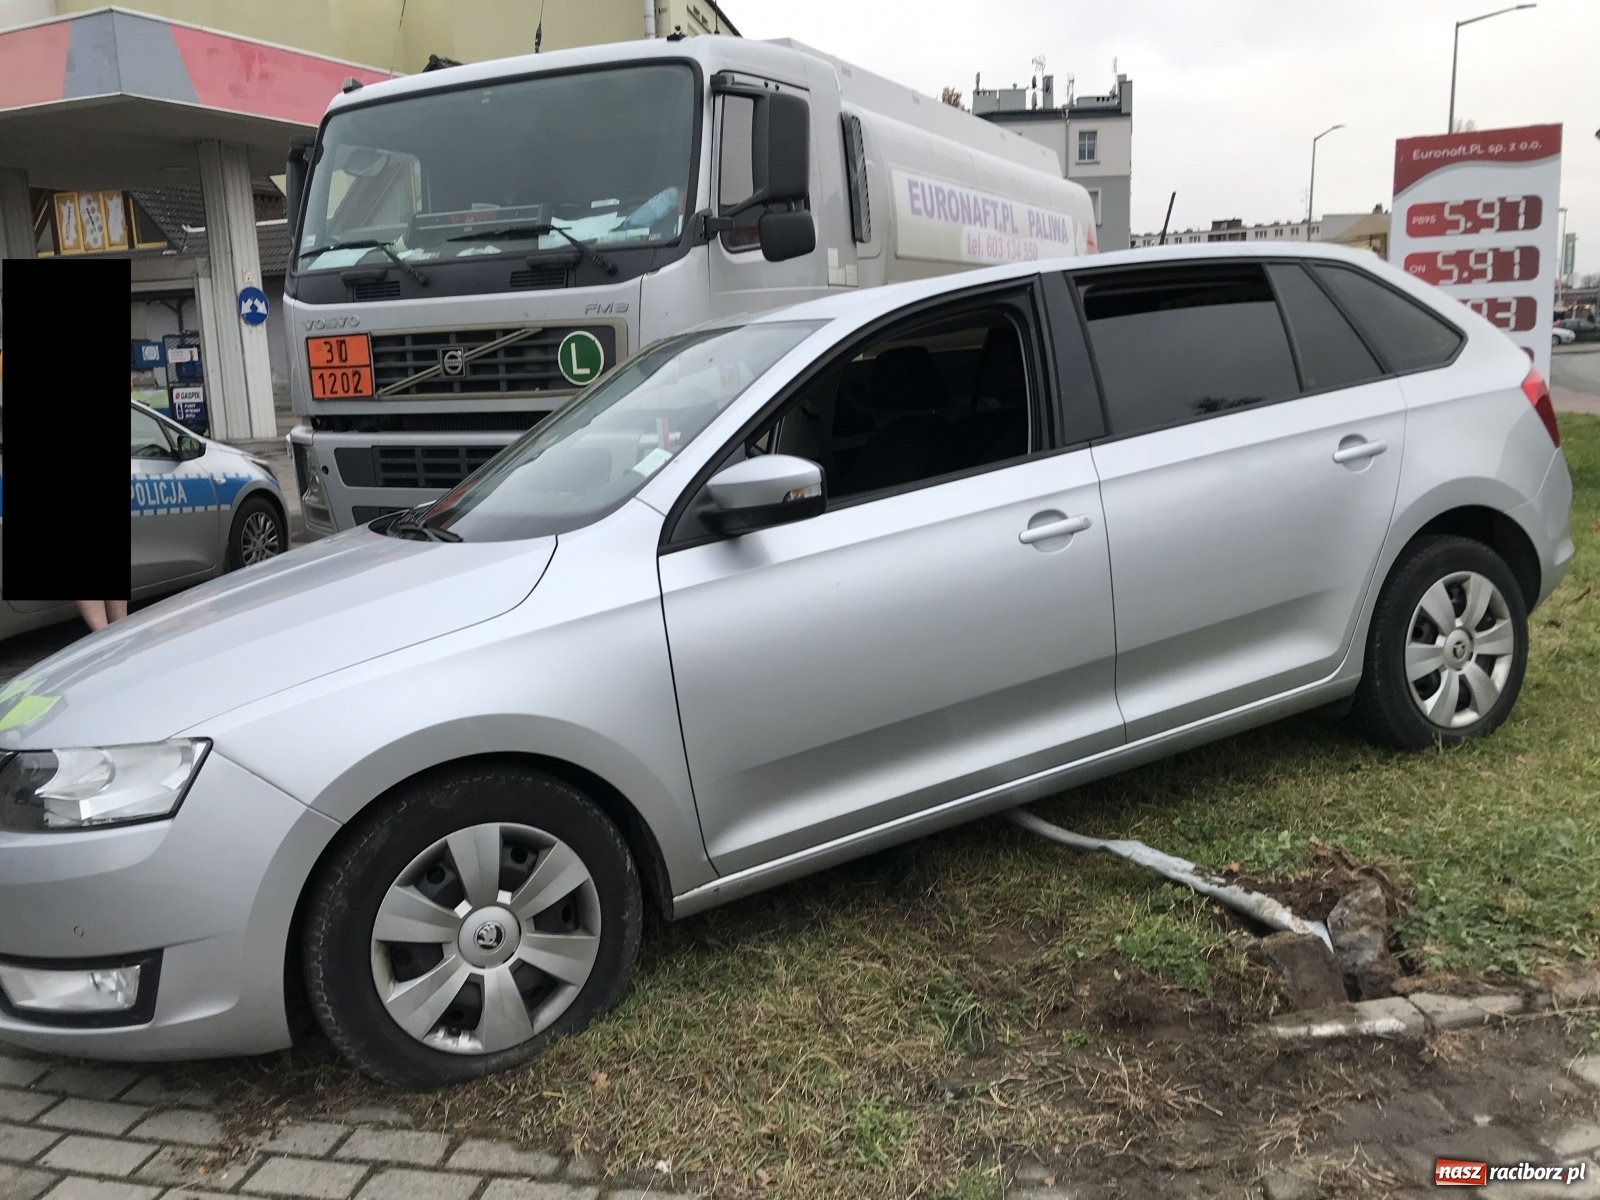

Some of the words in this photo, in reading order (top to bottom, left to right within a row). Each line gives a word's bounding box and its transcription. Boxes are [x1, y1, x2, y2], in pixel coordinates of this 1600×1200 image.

[1487, 144, 1506, 155] sp.
[907, 179, 1018, 234] EURONAFT.PL
[1027, 209, 1069, 243] PALIWA
[1443, 195, 1526, 236] 5.97
[967, 232, 984, 256] tel.
[986, 235, 1004, 258] 603
[1409, 264, 1426, 274] ON
[301, 315, 361, 332] VOLVO
[323, 339, 348, 364] 30
[570, 342, 591, 375] L
[318, 370, 363, 395] 1202
